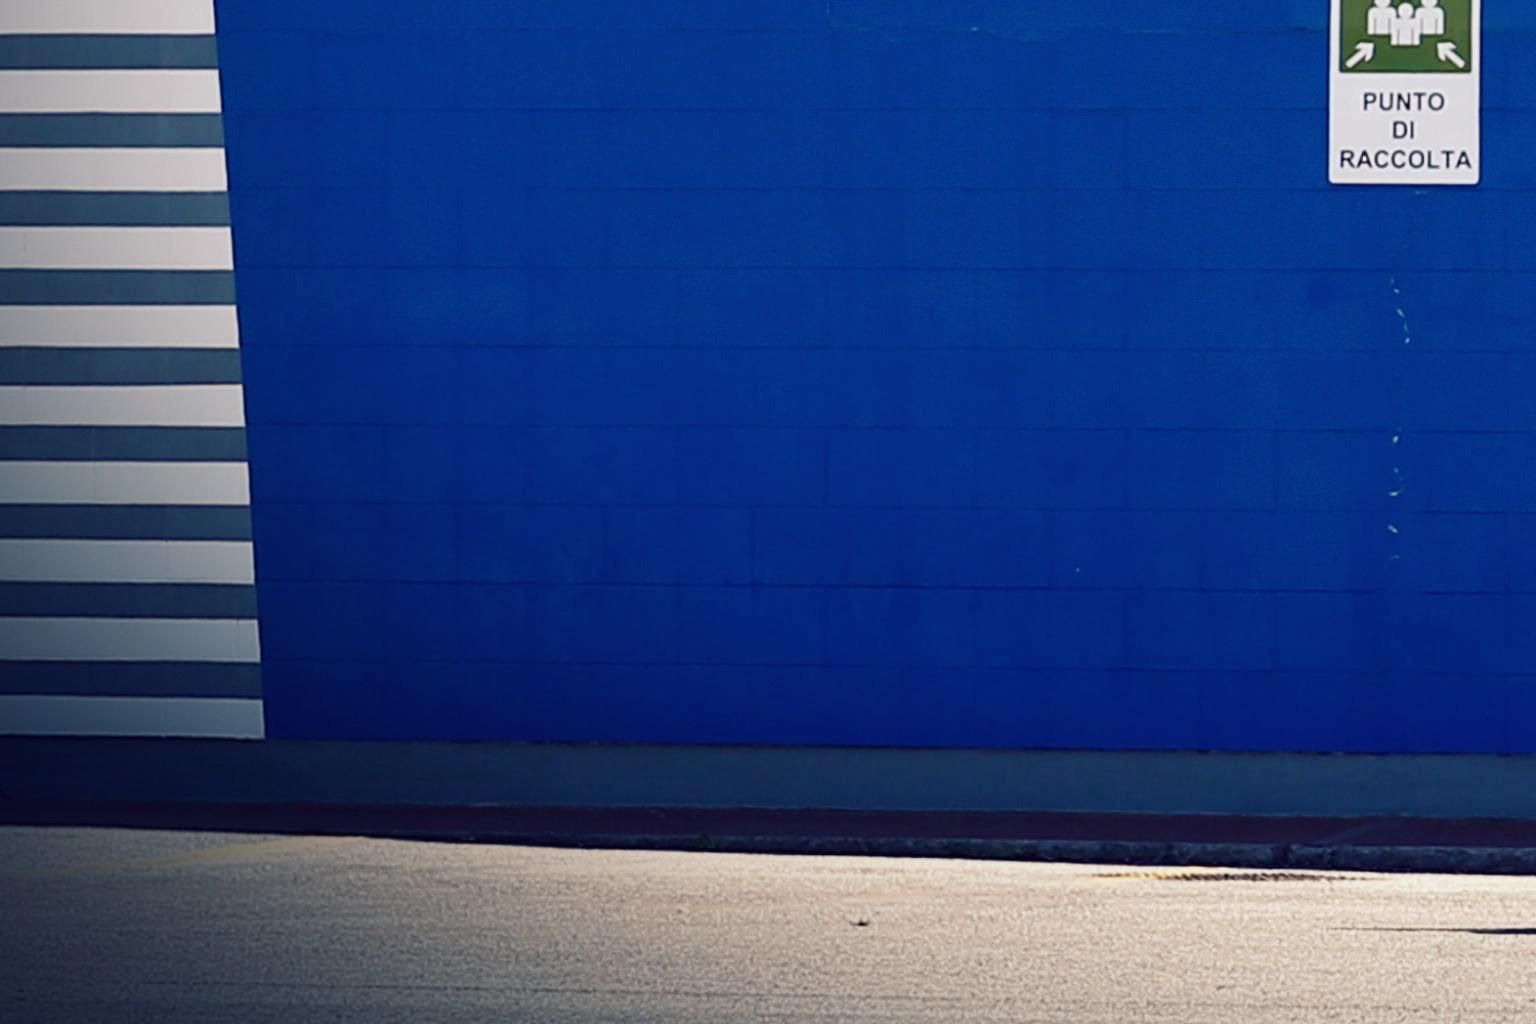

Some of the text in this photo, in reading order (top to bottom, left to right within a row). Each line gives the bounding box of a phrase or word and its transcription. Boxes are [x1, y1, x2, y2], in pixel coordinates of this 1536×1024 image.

[1362, 92, 1446, 112] PUNTO
[1392, 120, 1415, 140] DI
[1339, 149, 1472, 169] RACCOLTA
